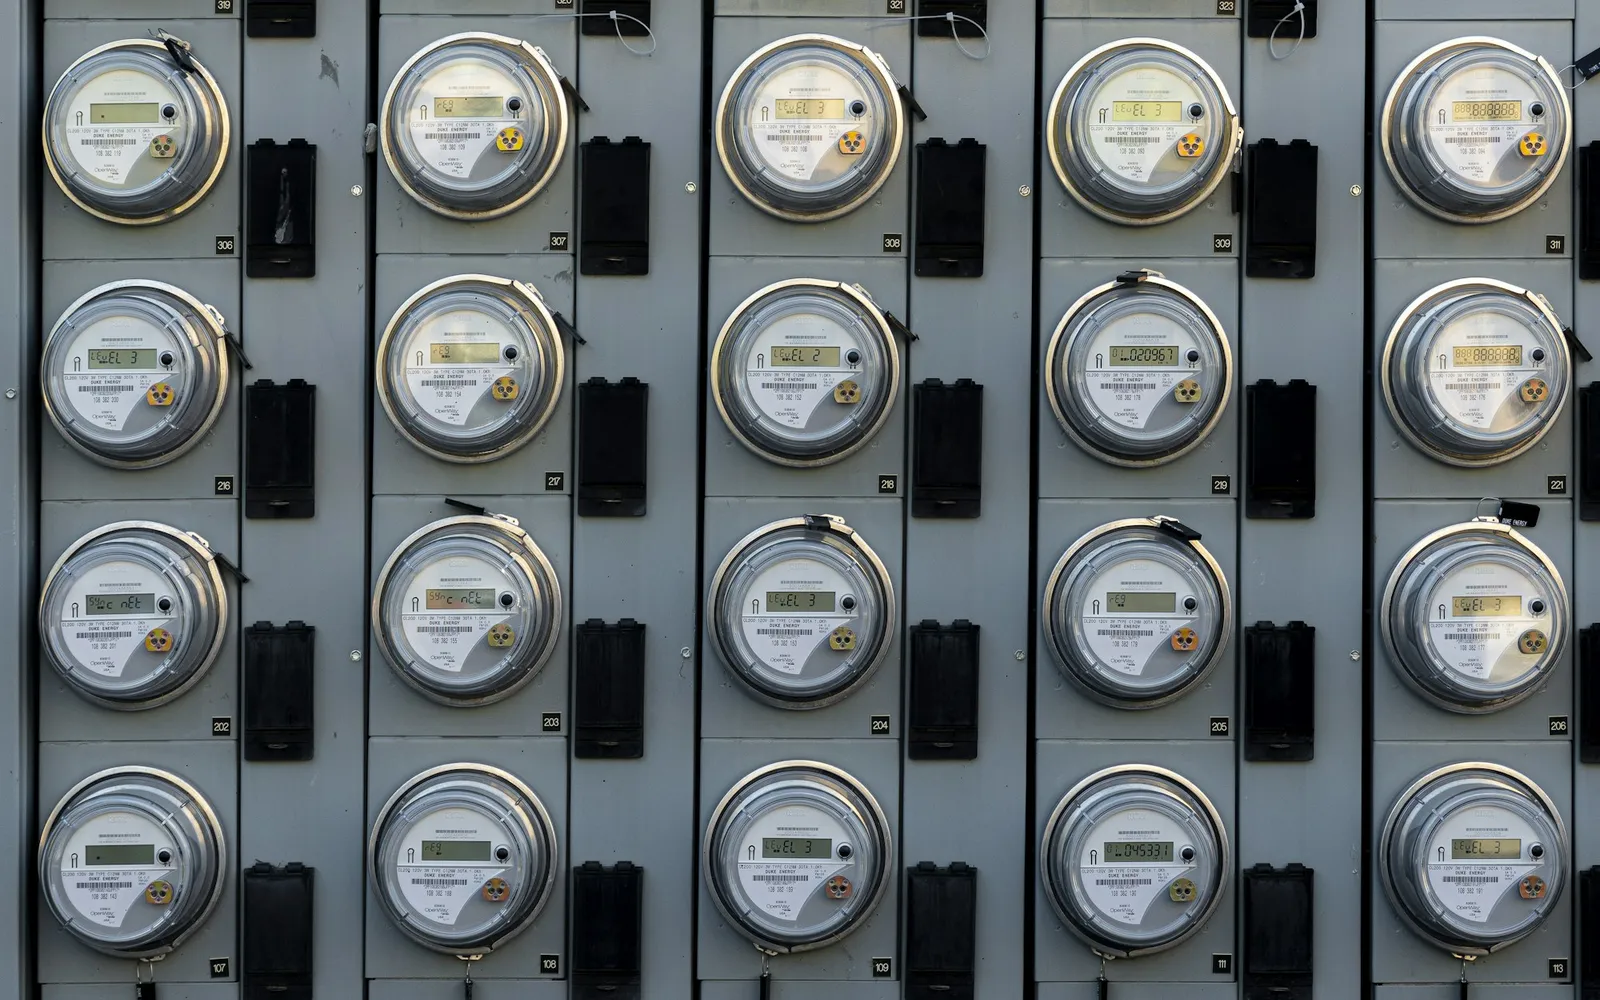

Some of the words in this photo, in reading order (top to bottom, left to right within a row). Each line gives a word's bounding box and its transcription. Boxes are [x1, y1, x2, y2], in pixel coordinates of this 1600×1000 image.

[218, 0, 230, 10] 319
[890, 0, 902, 10] 321
[1218, 0, 1234, 10] 323
[818, 101, 825, 114] 3
[1156, 103, 1162, 116] 3
[218, 240, 234, 250] 306
[550, 236, 566, 246] 307
[884, 238, 900, 248] 308
[1214, 238, 1230, 248] 309
[1550, 240, 1560, 250] 311
[131, 351, 137, 364] 3
[812, 348, 820, 362] 2
[218, 480, 230, 490] 216
[548, 476, 560, 486] 217
[882, 480, 894, 490] 218
[1214, 480, 1228, 490] 219
[1550, 480, 1564, 490] 221
[809, 593, 816, 607] 3
[1494, 598, 1502, 612] 3
[214, 722, 230, 732] 202
[544, 718, 560, 726] 203
[872, 720, 888, 730] 204
[1212, 722, 1228, 732] 205
[1550, 720, 1566, 730] 206
[805, 840, 812, 853] 3
[1494, 840, 1501, 854] 3
[214, 964, 226, 972] 107
[544, 960, 556, 968] 108
[876, 962, 890, 972] 109
[1218, 960, 1226, 968] 111
[1554, 964, 1564, 974] 113
